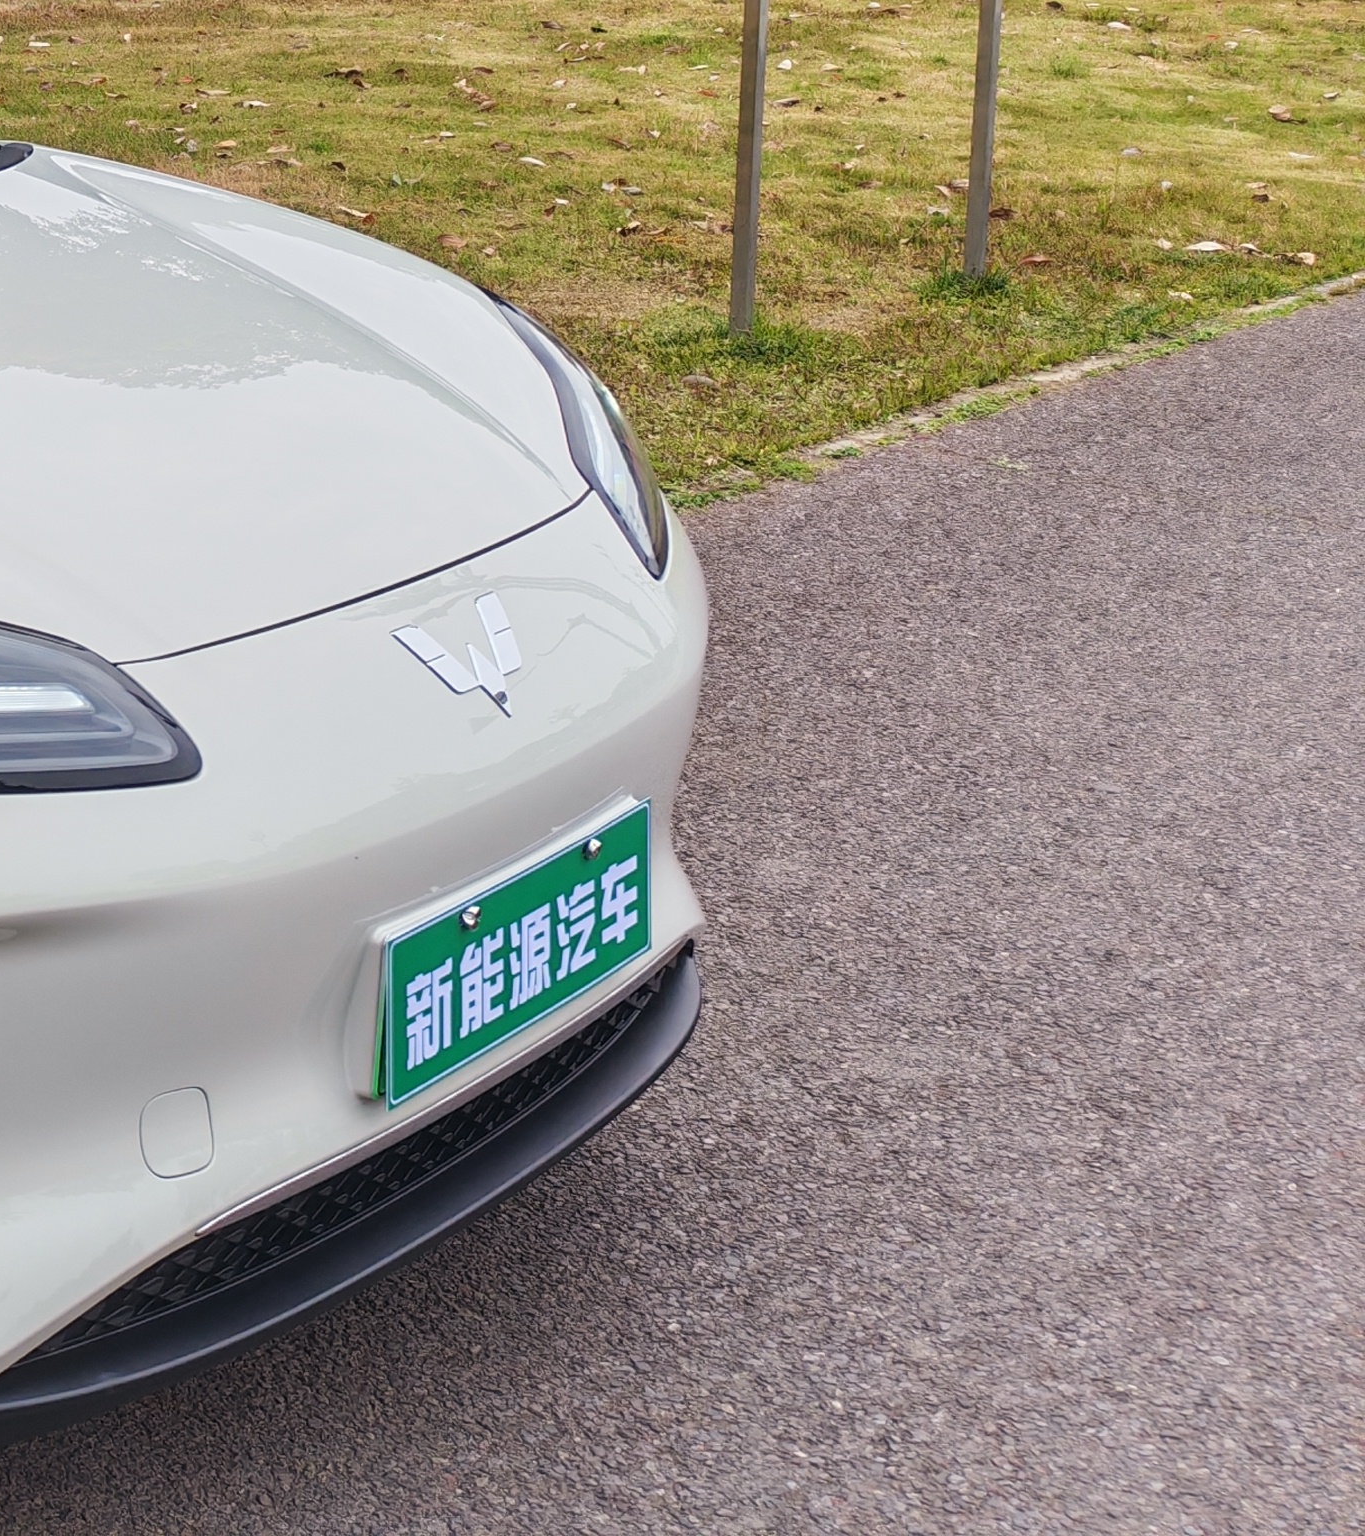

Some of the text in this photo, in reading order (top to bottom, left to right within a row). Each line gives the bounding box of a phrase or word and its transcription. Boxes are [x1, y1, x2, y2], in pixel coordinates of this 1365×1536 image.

[407, 855, 638, 1071] 新能源汽车
